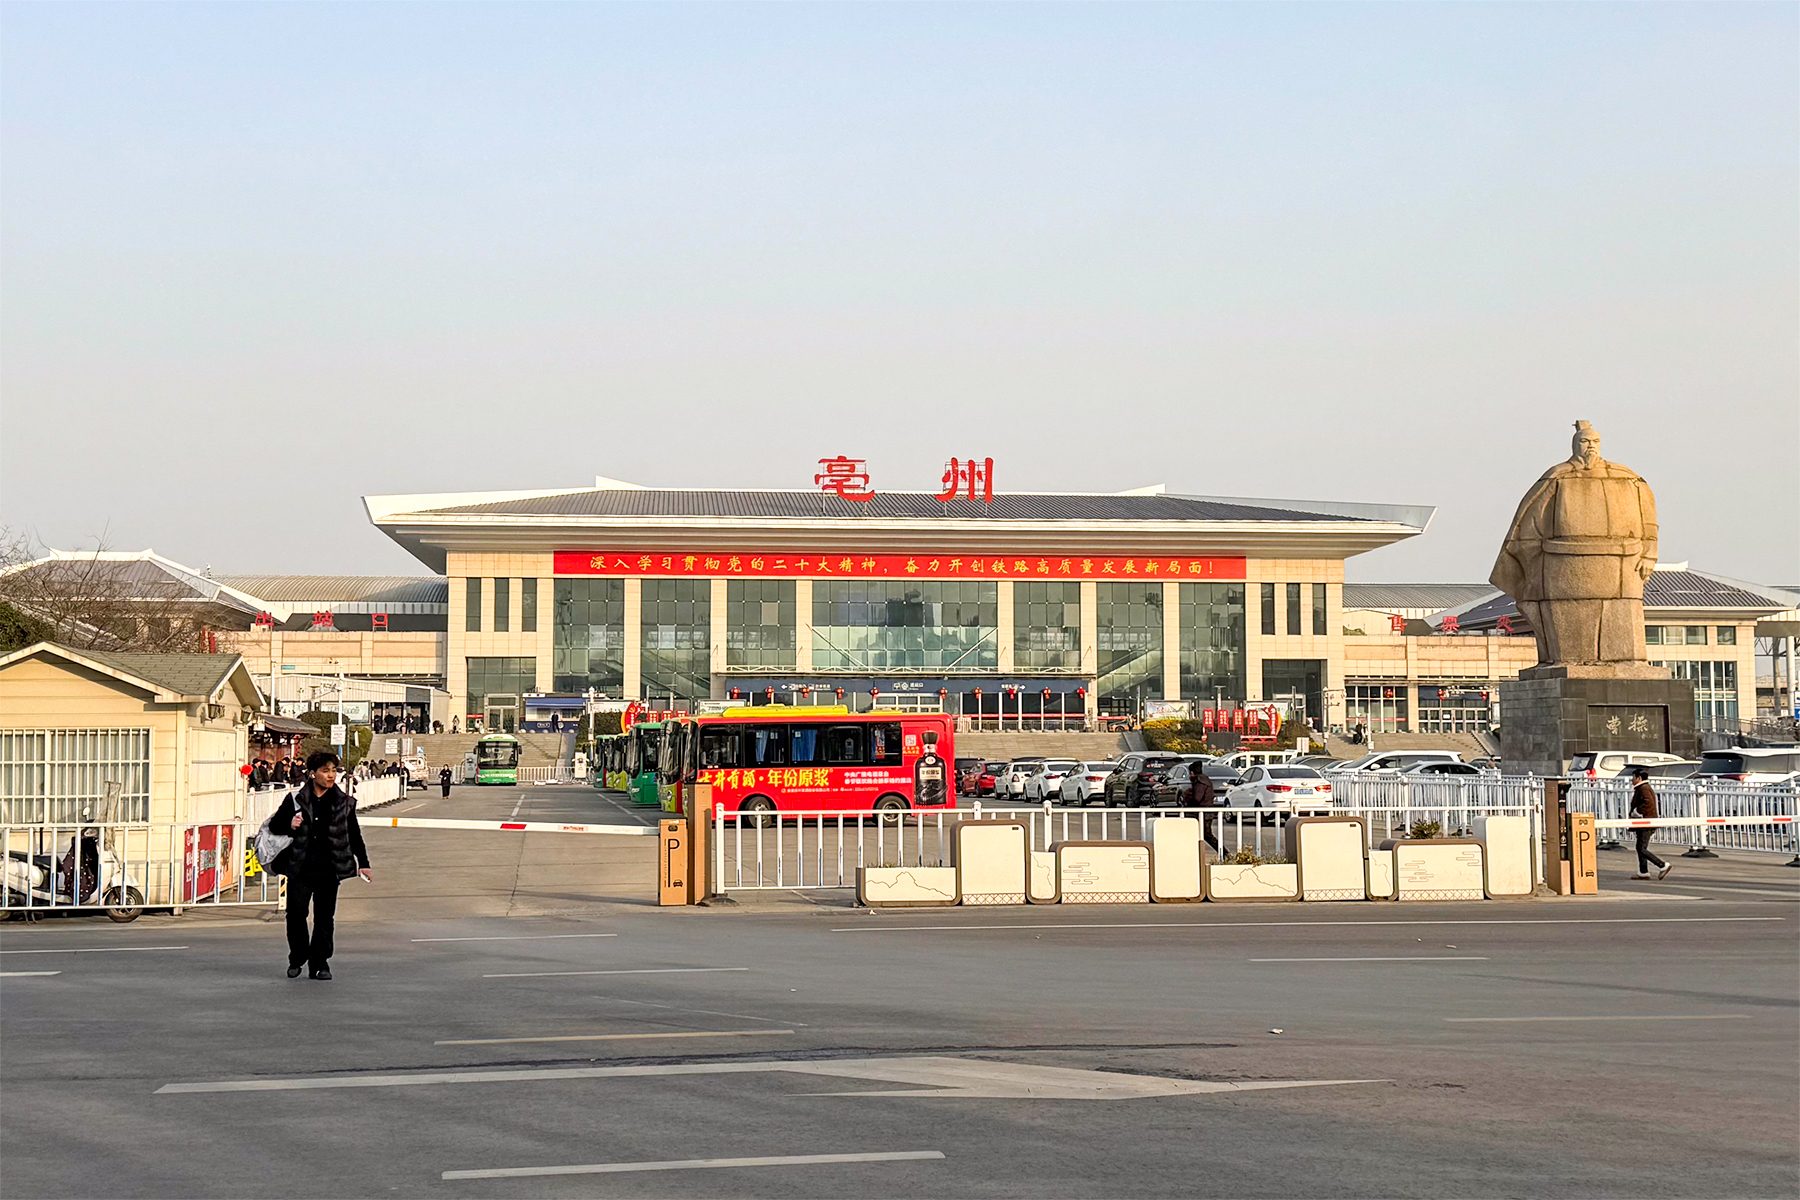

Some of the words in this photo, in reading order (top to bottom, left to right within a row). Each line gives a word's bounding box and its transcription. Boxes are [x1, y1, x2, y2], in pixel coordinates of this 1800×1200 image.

[814, 455, 994, 504] 亳州
[255, 610, 389, 627] 出站口
[1386, 614, 1515, 633] 售票处
[1606, 713, 1648, 735] 曹操
[667, 838, 680, 888] P
